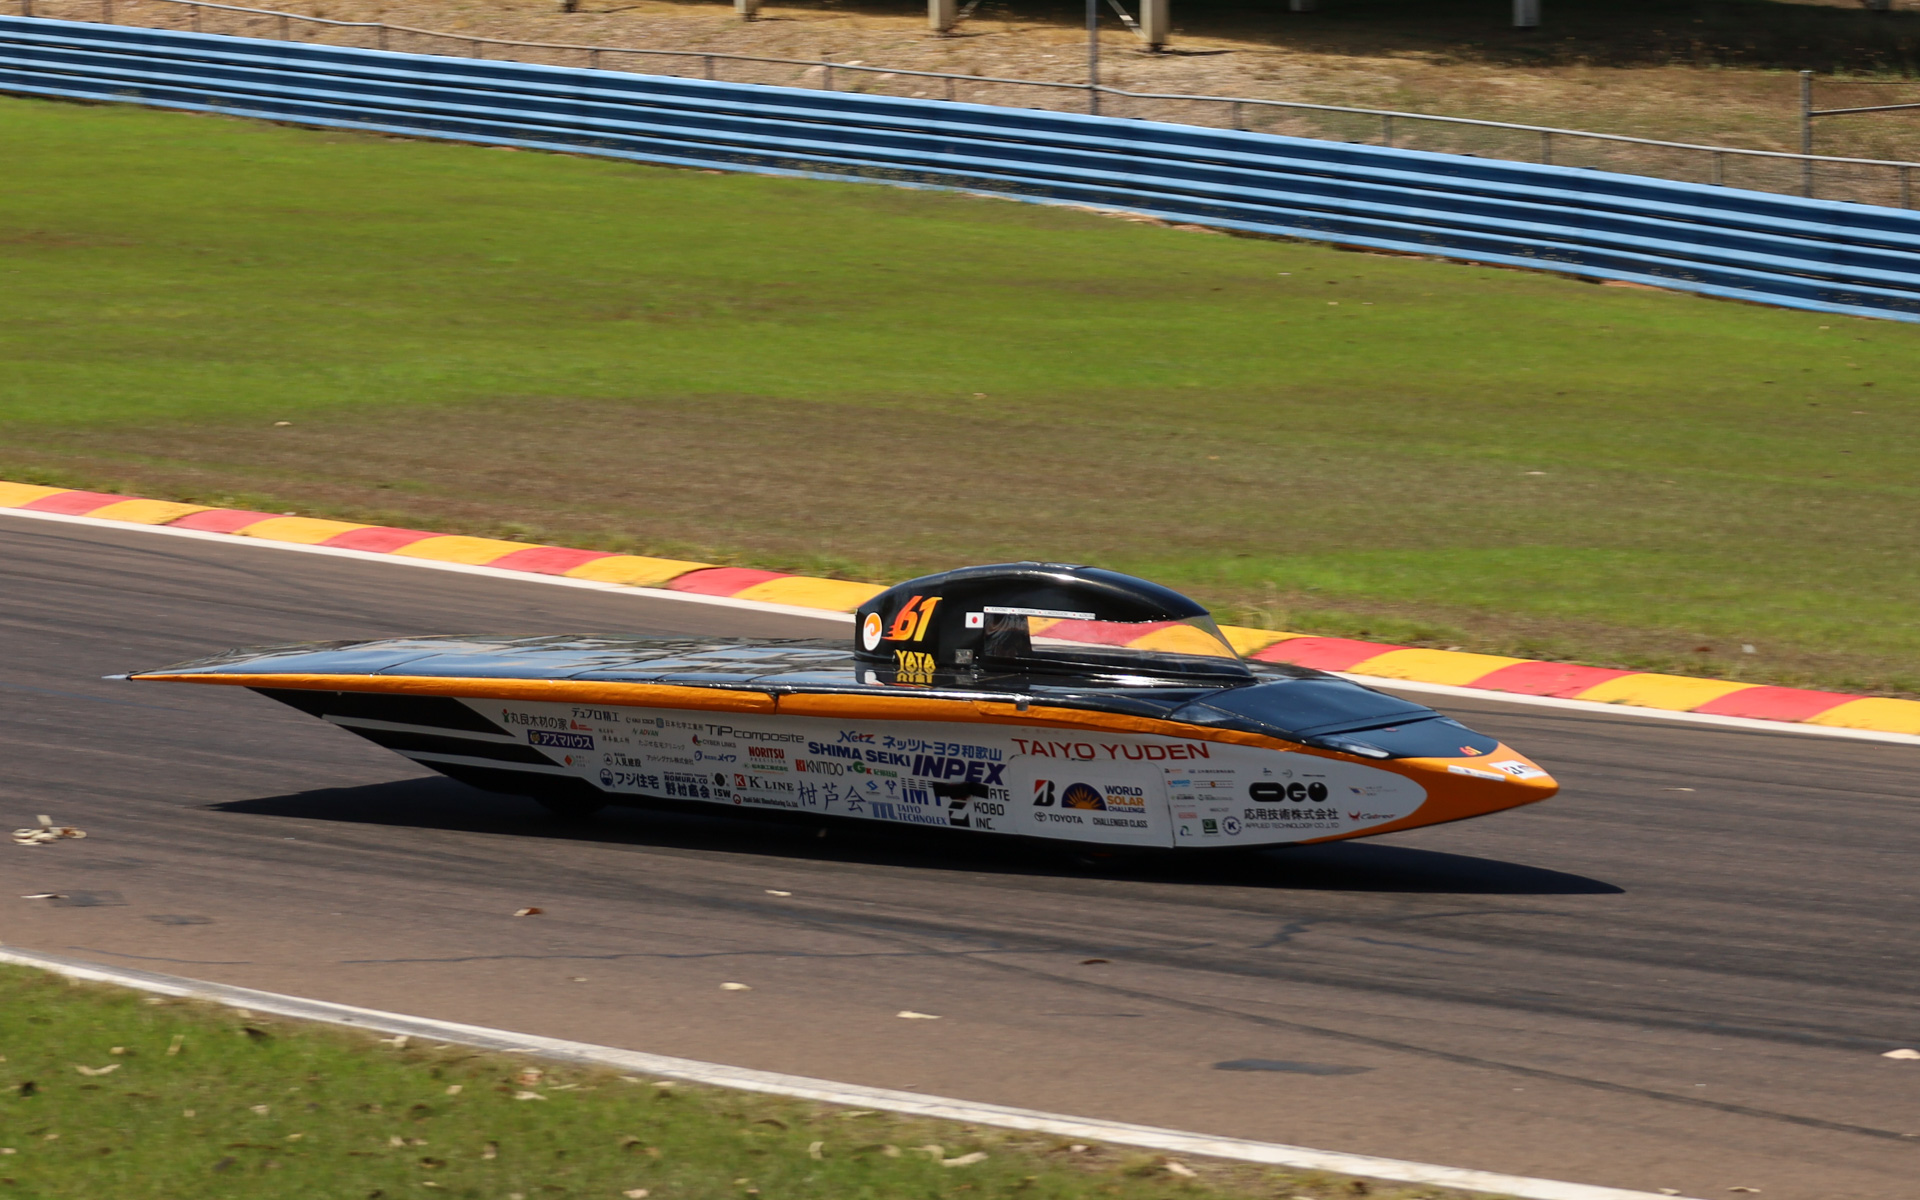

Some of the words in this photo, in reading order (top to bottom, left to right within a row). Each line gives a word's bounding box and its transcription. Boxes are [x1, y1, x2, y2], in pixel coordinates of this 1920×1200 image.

[882, 595, 944, 642] 61
[895, 649, 937, 673] YATA
[510, 712, 569, 731] 丸良木材の家
[734, 730, 805, 744] composite
[837, 730, 876, 745] Netz
[748, 746, 786, 759] NORITSU
[808, 742, 864, 761] SHIMA
[865, 749, 911, 767] SEIKI
[883, 736, 1003, 762] ネッツトヨタ和歌山
[1010, 738, 1096, 761] TAIYO
[1100, 742, 1212, 761] YUDEN
[805, 759, 845, 777] KNITIDO
[912, 754, 1007, 786] INPEX
[615, 772, 660, 790] フジ住宅
[664, 774, 709, 785] NOMURA.CO
[764, 780, 795, 792] LINE
[797, 780, 867, 813] 柑芦会
[1104, 785, 1143, 797] WORLD
[897, 803, 922, 814] TAIYO
[1107, 795, 1145, 807] SOLAR
[974, 801, 1005, 817] KOBO
[1108, 805, 1147, 814] CHALLENGE
[1244, 808, 1340, 821] 応用技術株式会社
[898, 812, 948, 827] TECHNOLEX
[975, 816, 996, 831] INC.
[1048, 813, 1084, 824] TOYOTA
[1092, 817, 1129, 828] CHALLENGER
[1129, 819, 1149, 828] CLASS
